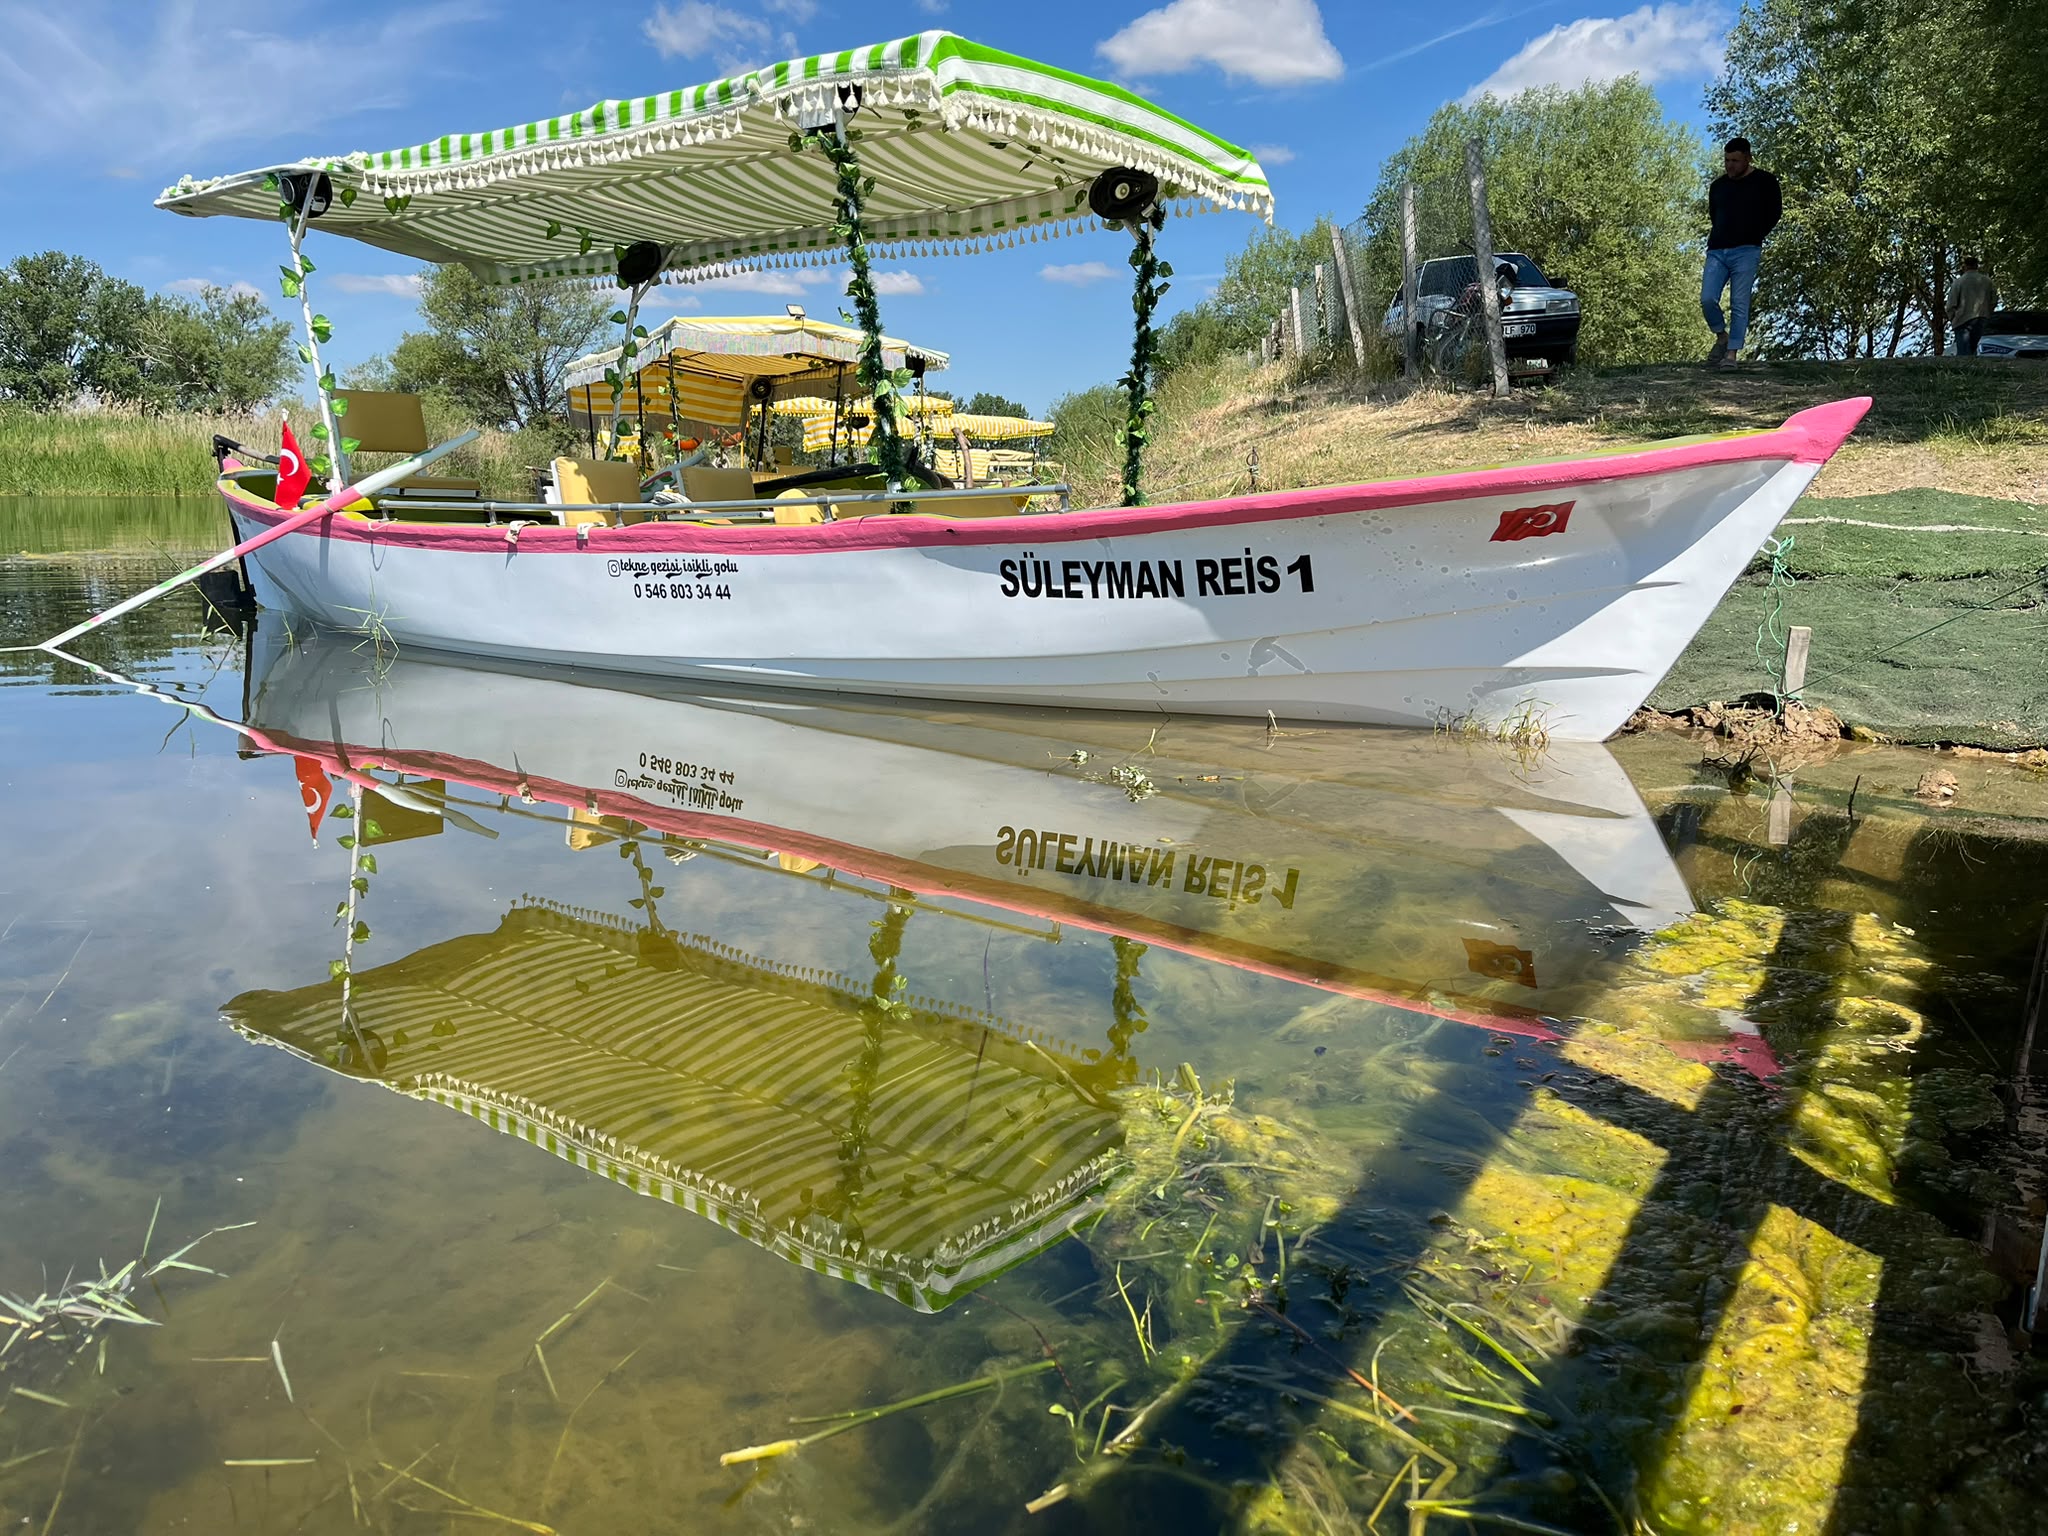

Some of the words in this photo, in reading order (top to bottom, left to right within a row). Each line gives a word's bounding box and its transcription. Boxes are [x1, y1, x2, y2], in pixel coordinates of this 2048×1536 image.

[1520, 324, 1535, 334] 970
[714, 559, 738, 576] golu
[1000, 552, 1185, 599] SÜLEYMAN
[1195, 547, 1281, 596] REİS
[1287, 554, 1315, 593] 1
[634, 583, 642, 599] 0
[645, 583, 667, 599] 546
[670, 583, 693, 599] 803
[696, 584, 712, 599] 34
[715, 584, 731, 600] 44
